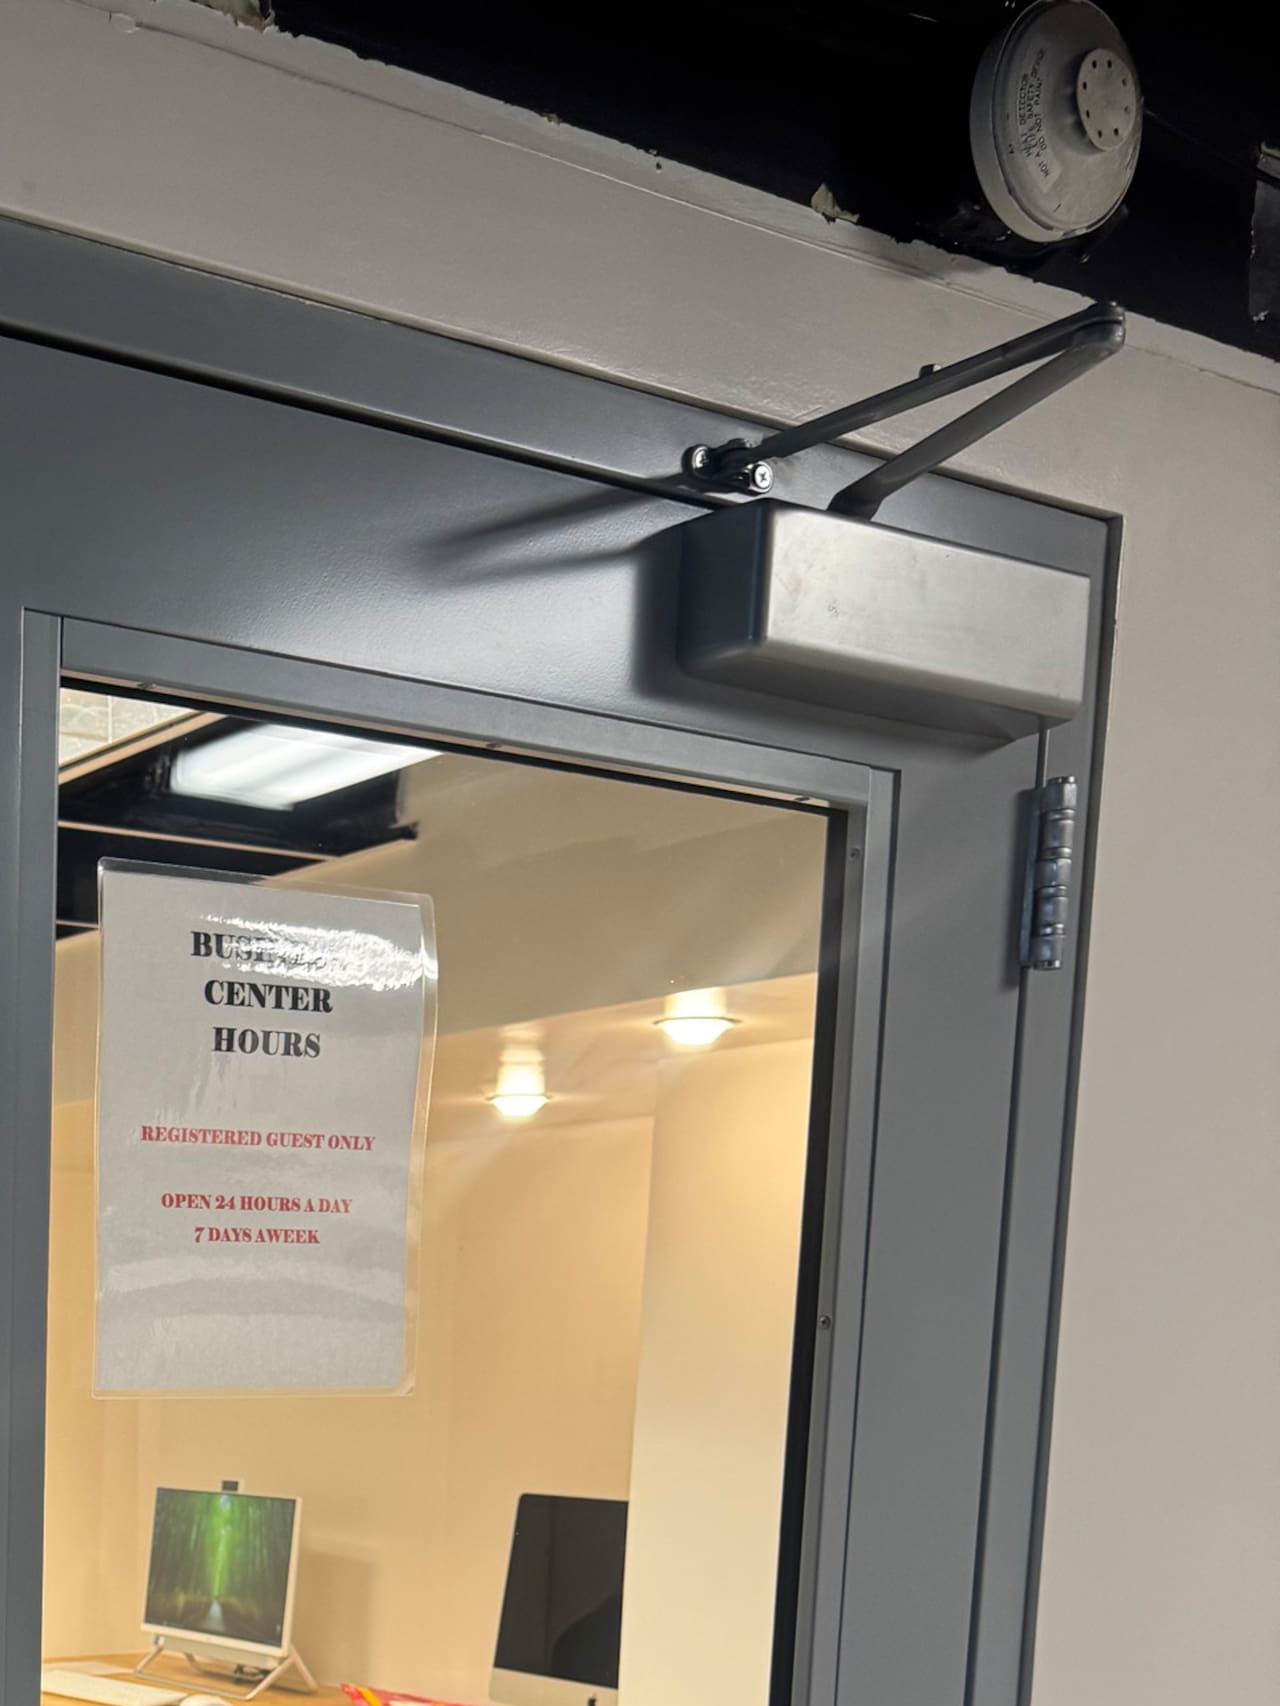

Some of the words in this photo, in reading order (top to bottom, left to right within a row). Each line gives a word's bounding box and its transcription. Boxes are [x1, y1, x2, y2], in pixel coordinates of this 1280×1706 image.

[1017, 73, 1029, 125] DETECTOR
[1035, 112, 1043, 132] NOT
[1038, 135, 1048, 151] DO
[204, 979, 333, 1013] CENTER
[212, 1026, 321, 1058] HOURS
[141, 1125, 262, 1146] REGISTERED
[266, 1132, 325, 1149] GUEST
[327, 1135, 376, 1151] ONLY
[161, 1193, 212, 1209] OPEN
[215, 1195, 235, 1210] 24
[239, 1196, 301, 1212] HOURS
[304, 1198, 316, 1212] A
[318, 1199, 352, 1213] DAY
[194, 1226, 205, 1243] 7
[208, 1227, 252, 1242] DAYS
